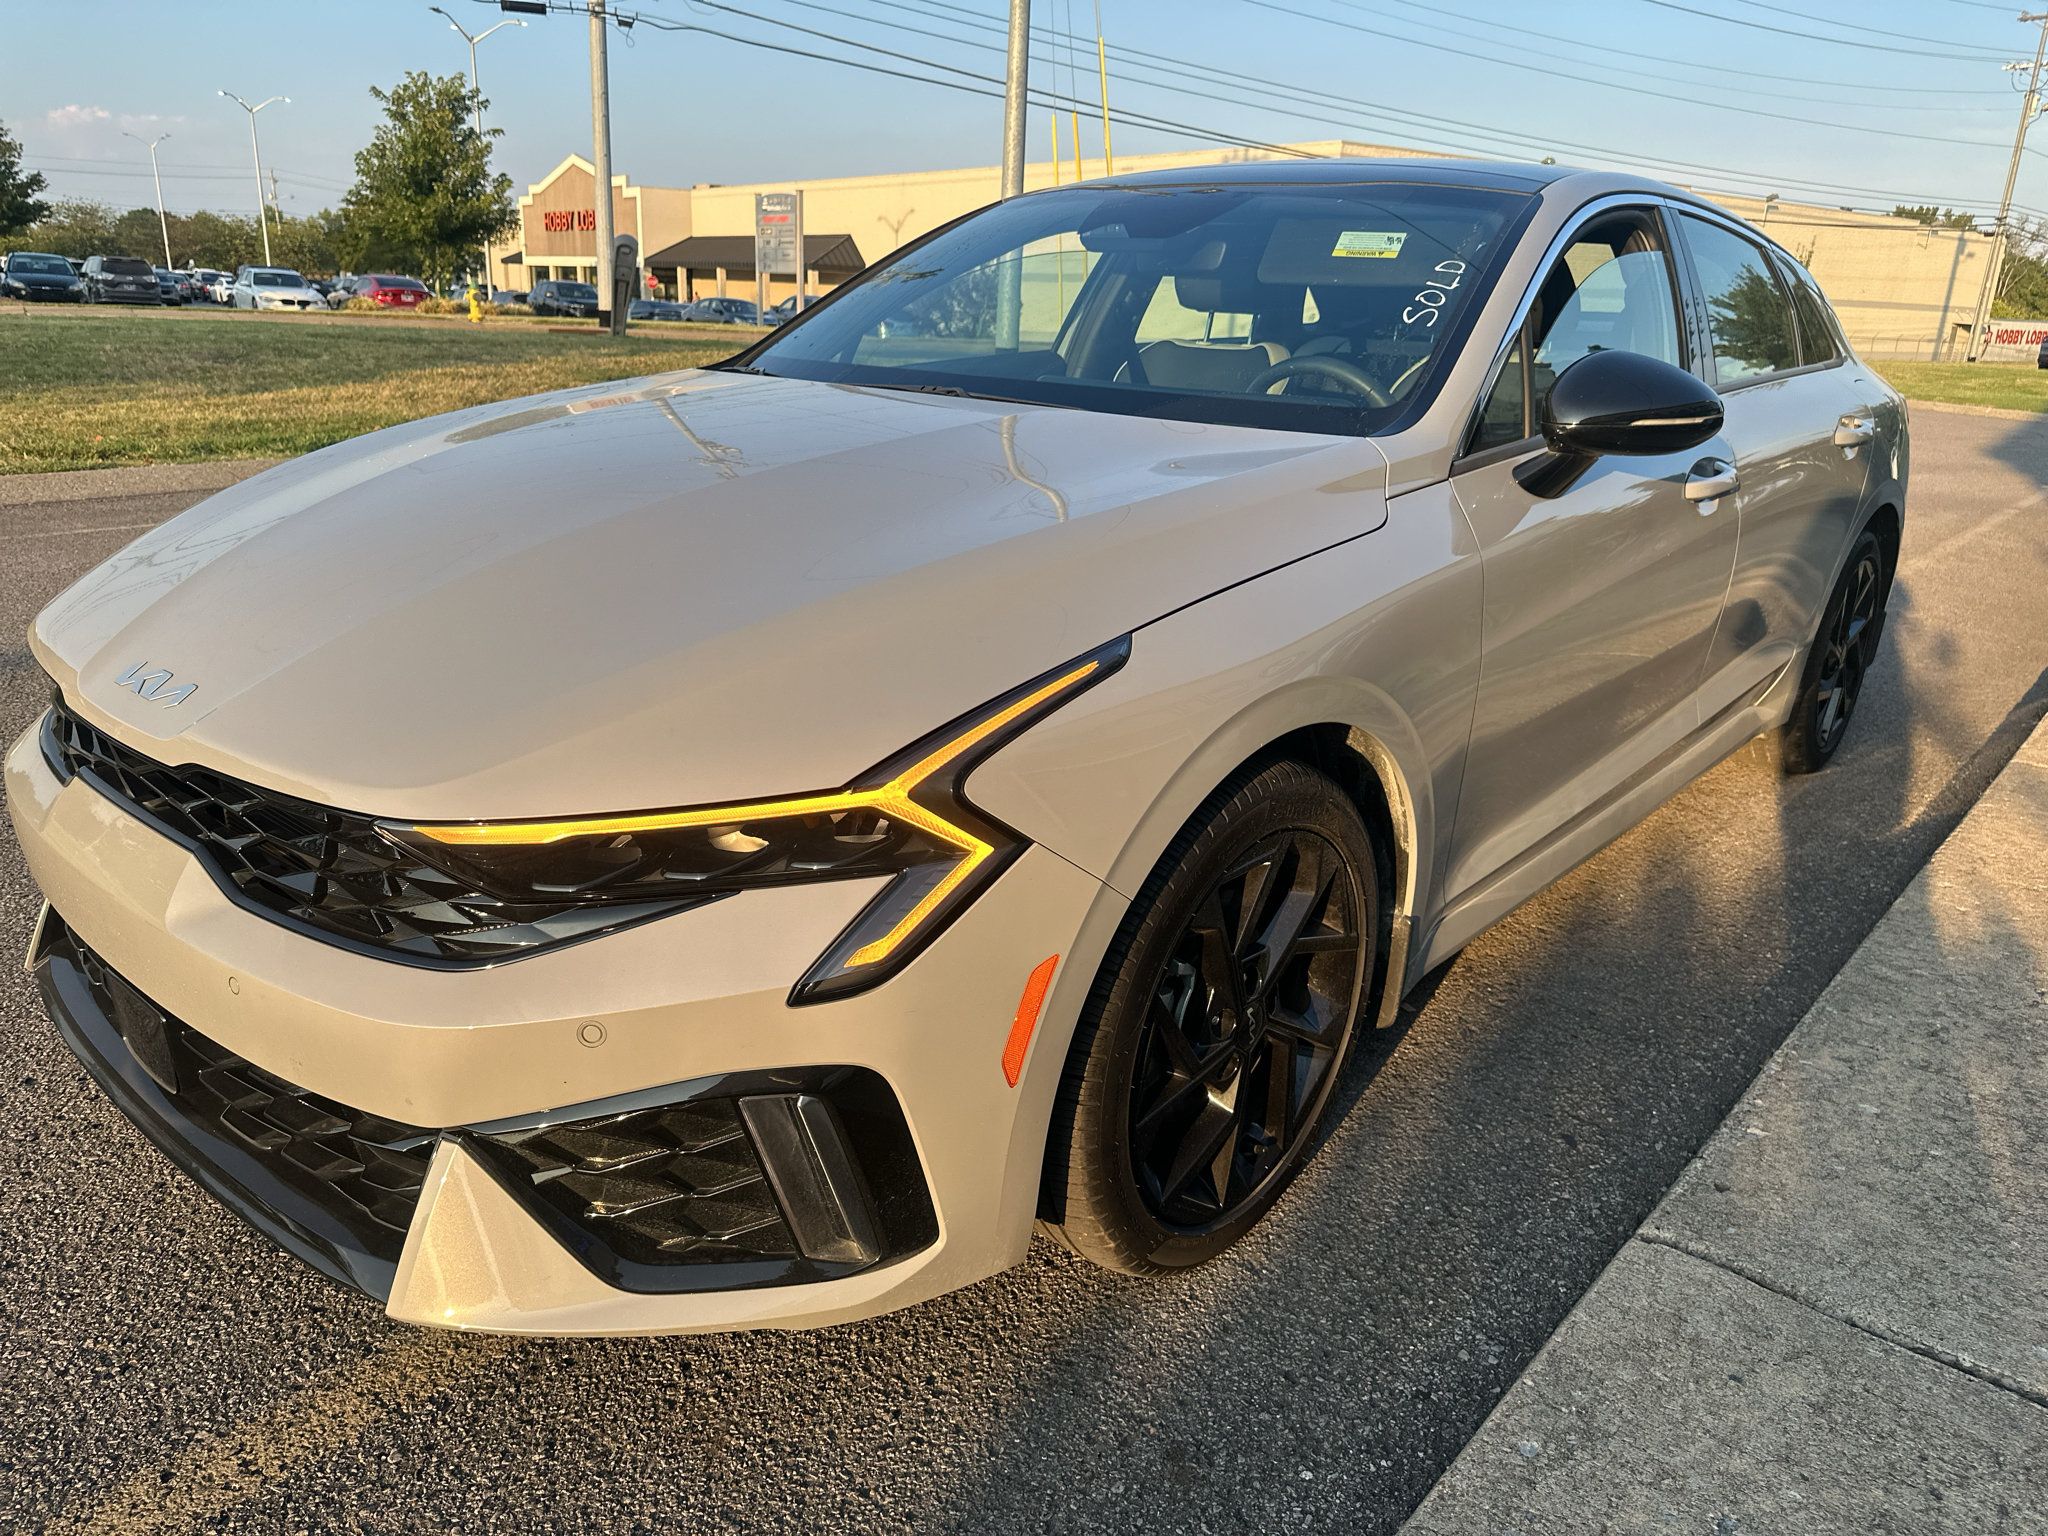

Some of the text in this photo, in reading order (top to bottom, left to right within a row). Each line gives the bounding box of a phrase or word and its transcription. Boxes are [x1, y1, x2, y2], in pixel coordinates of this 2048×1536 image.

[544, 209, 596, 232] HOBBY LOB
[1402, 260, 1466, 327] SOLD
[1994, 329, 2026, 345] HOBBY
[113, 660, 199, 710] KIA
